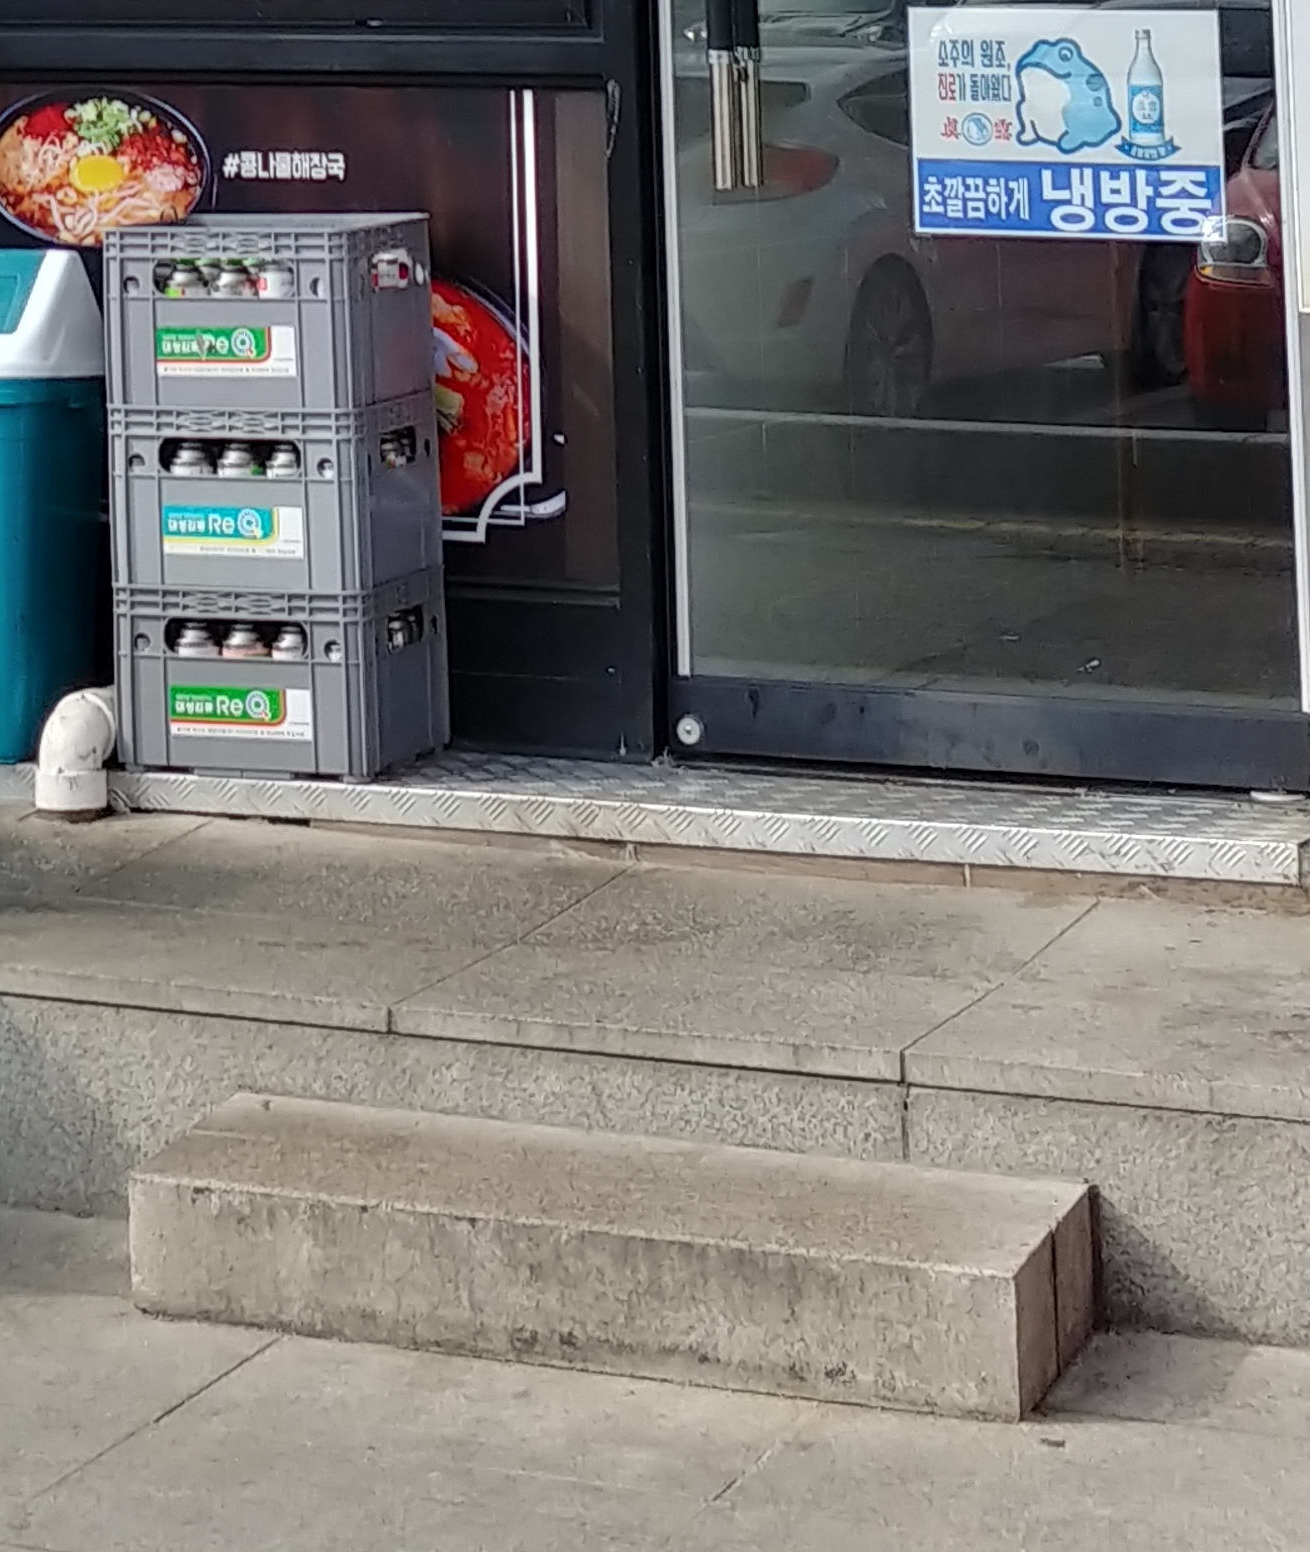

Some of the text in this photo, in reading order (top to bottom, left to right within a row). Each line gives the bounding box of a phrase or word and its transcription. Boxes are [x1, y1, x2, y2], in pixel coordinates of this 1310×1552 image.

[938, 39, 975, 68] 소주의
[938, 73, 1012, 102] 진로가 돌아왔다
[222, 151, 346, 183] #콩나물해장국
[922, 166, 1213, 235] 초깔끔하게 냉방중
